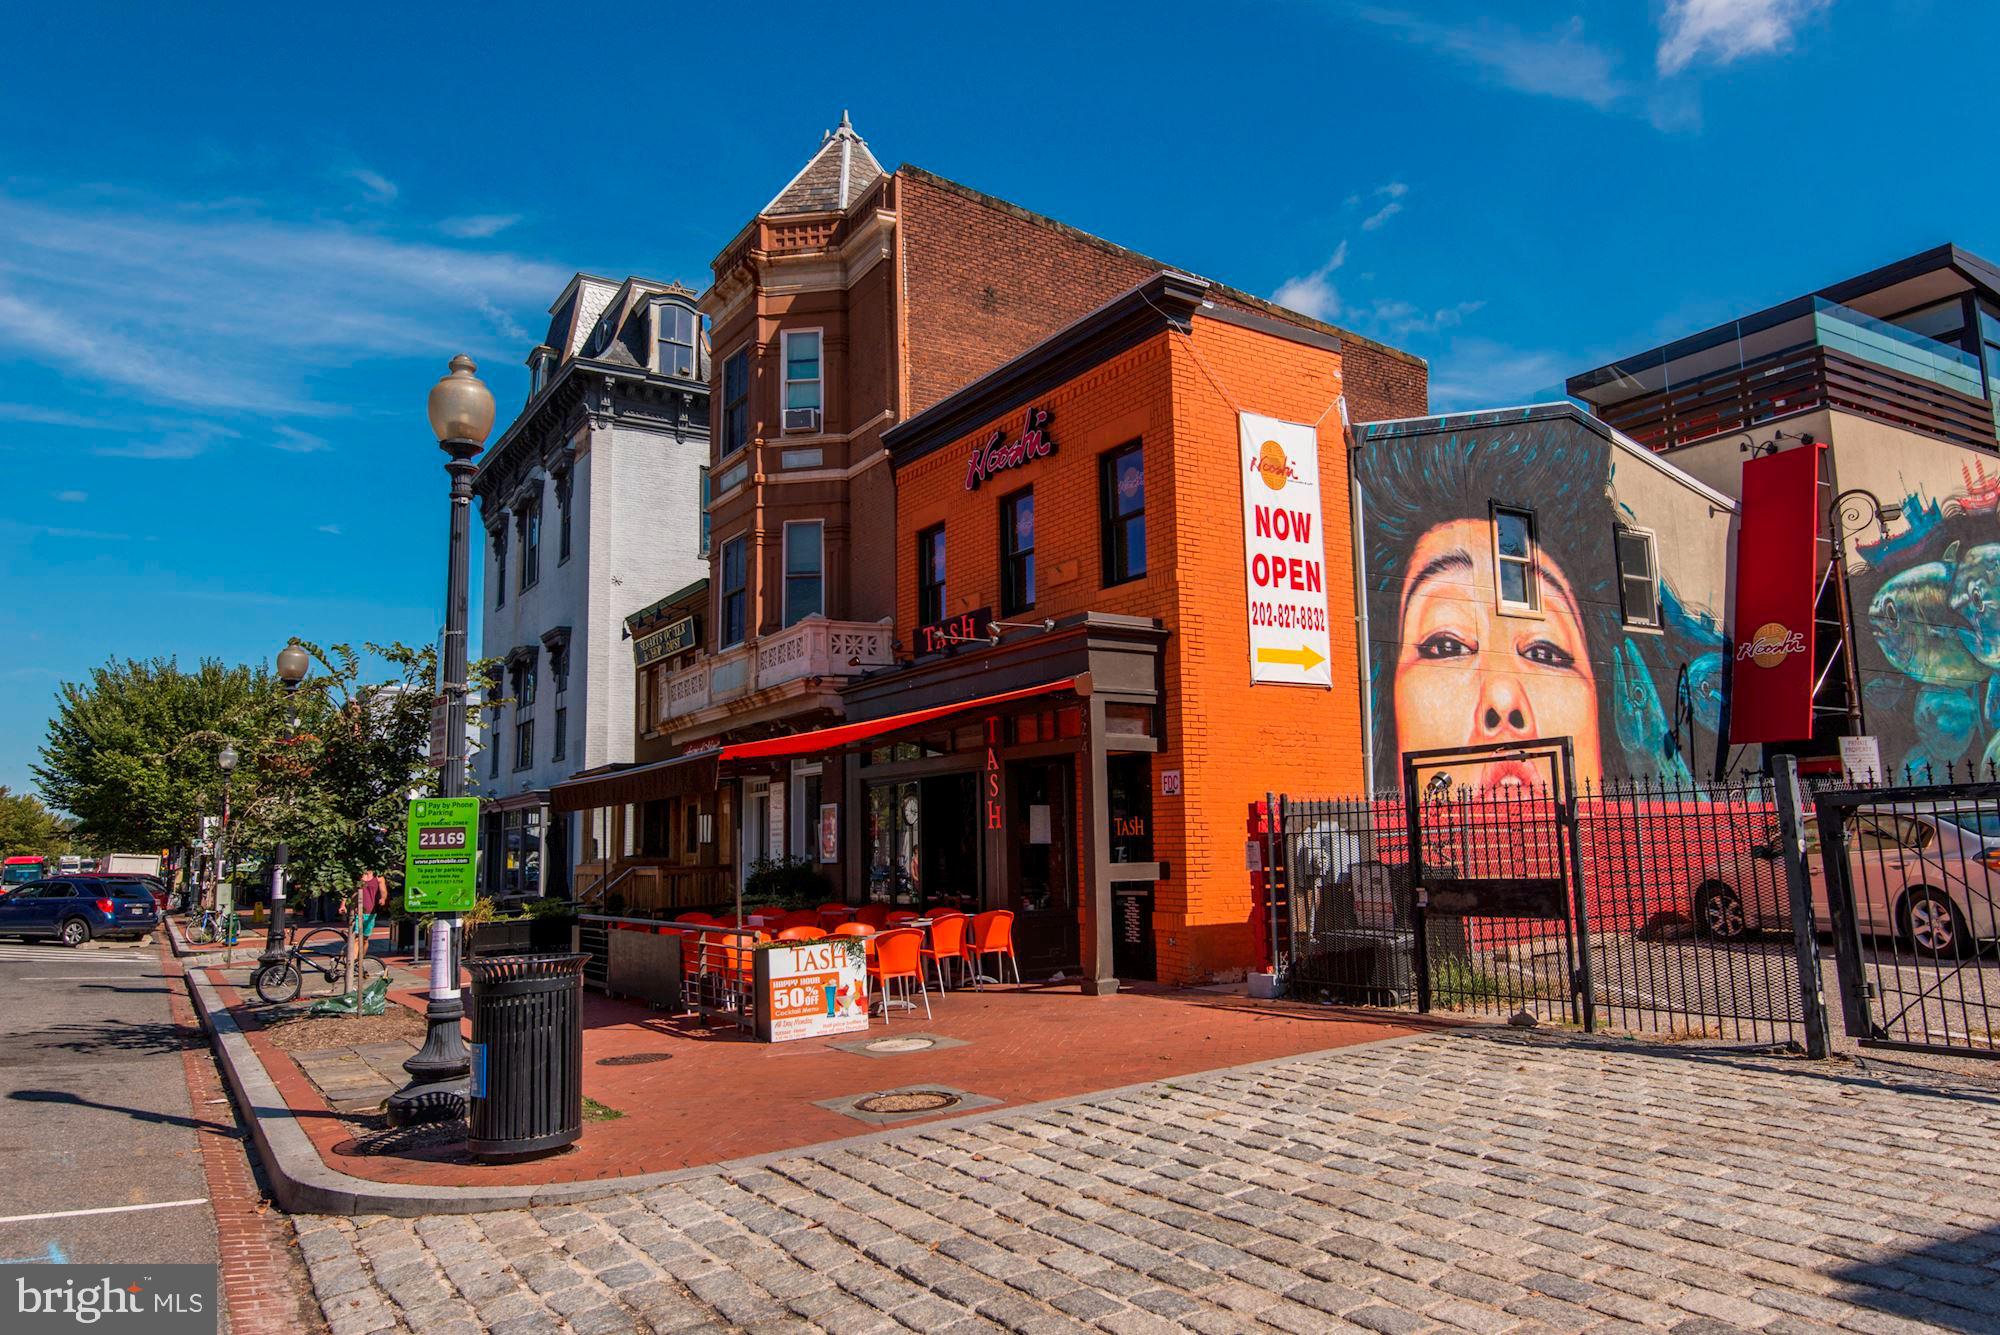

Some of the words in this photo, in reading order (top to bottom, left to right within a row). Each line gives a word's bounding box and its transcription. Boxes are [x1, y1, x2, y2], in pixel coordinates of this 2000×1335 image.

[965, 407, 1051, 490] Nooshi
[1250, 455, 1299, 480] Nooshi
[1255, 504, 1312, 544] NOW
[1252, 553, 1321, 593] OPEN
[1252, 601, 1325, 632] 202-827-8832
[923, 614, 976, 652] TASH
[1736, 629, 1806, 661] Nooshi
[986, 716, 1002, 829] TASH
[1163, 775, 1179, 791] FDC
[428, 809, 454, 817] Parking
[1114, 816, 1145, 836] TASH
[420, 832, 465, 846] 21169
[790, 943, 848, 972] TASH
[773, 979, 798, 987] HAPPY
[800, 976, 820, 986] HOUR
[775, 1008, 801, 1016] Cocktail
[805, 994, 819, 1006] OFF
